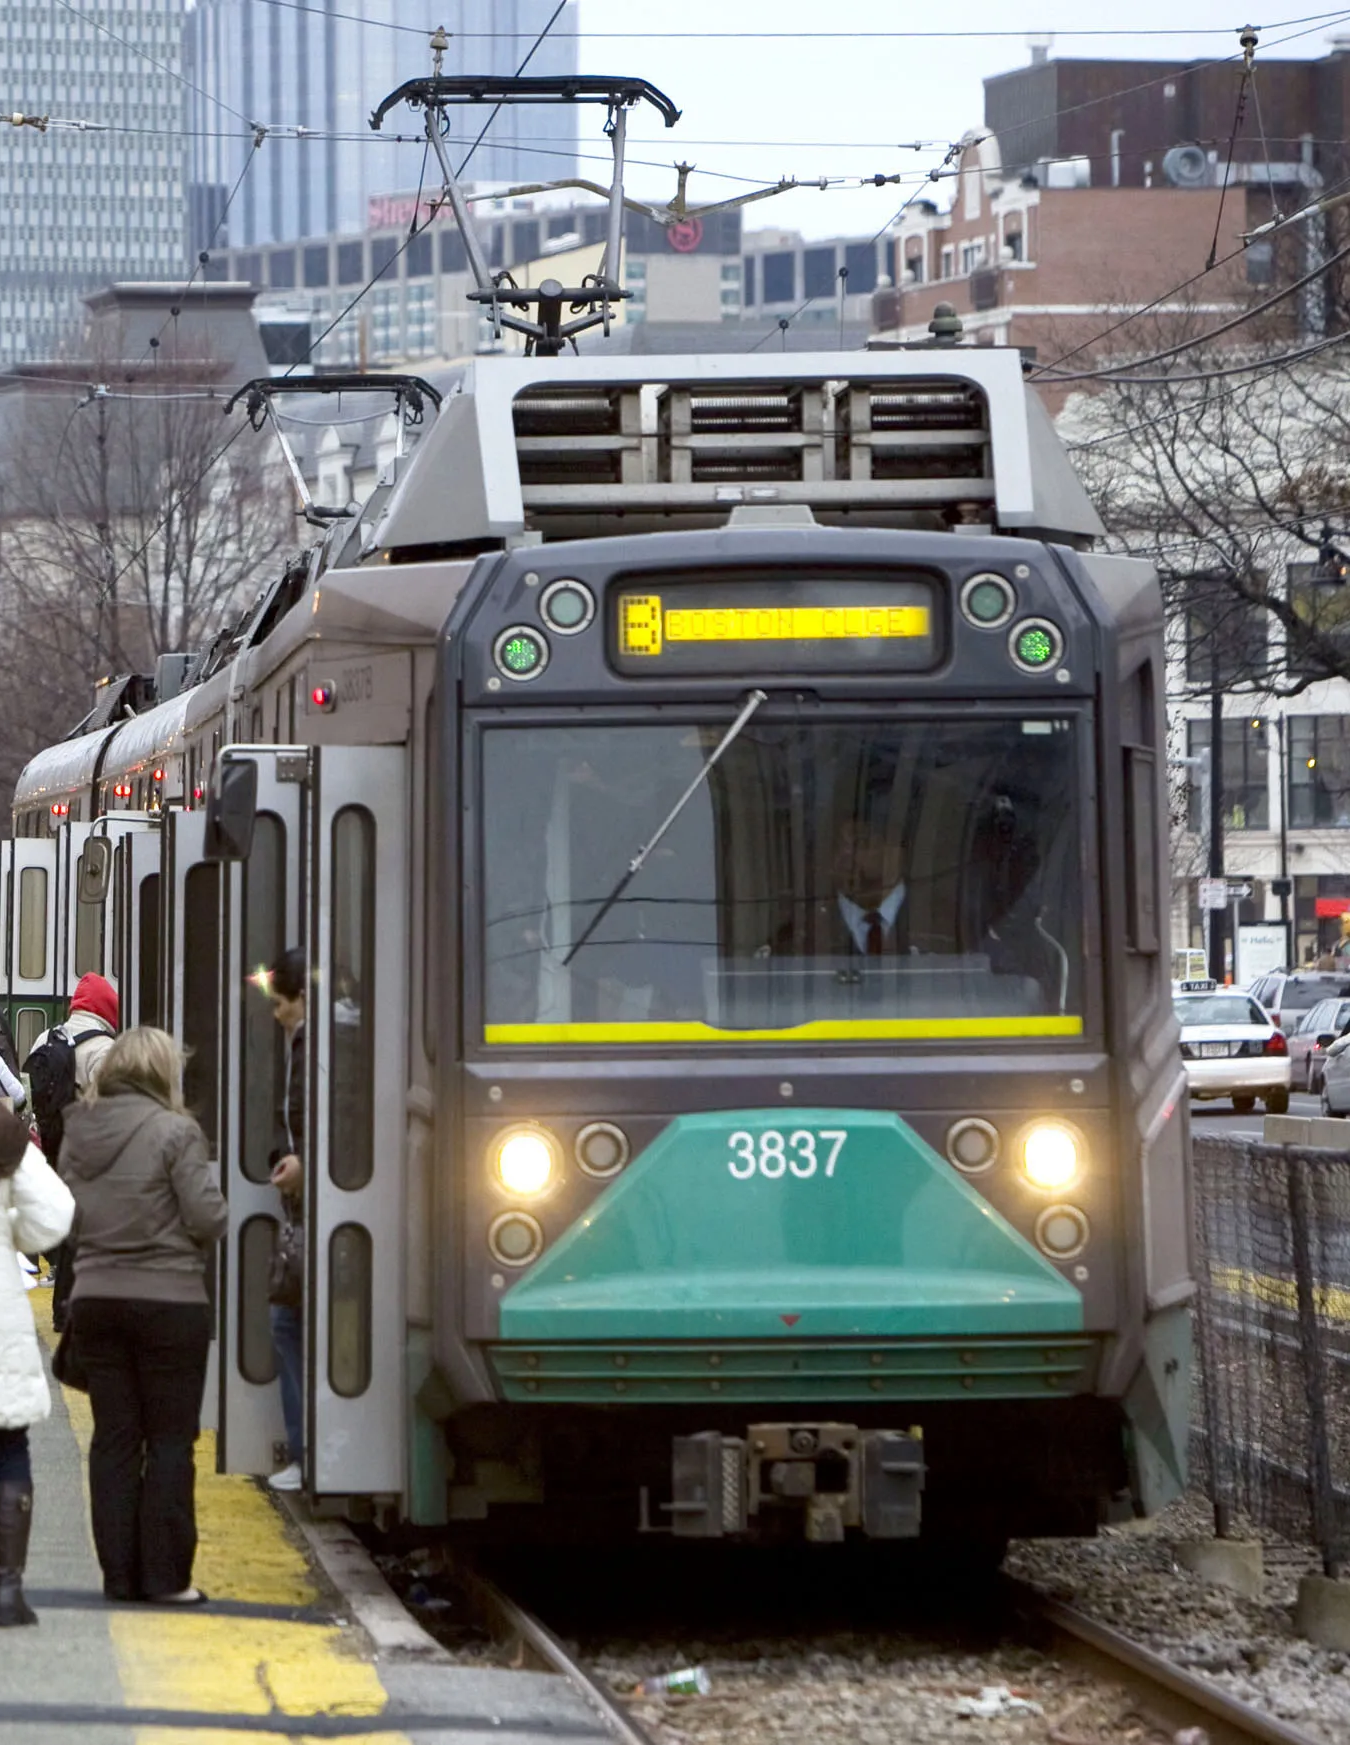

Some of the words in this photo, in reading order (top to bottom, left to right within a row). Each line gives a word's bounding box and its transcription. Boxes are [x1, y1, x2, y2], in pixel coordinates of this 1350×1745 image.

[622, 597, 658, 653] B
[669, 609, 794, 637] BOSTON
[822, 607, 905, 635] CLGE
[1190, 983, 1208, 991] TAXI
[728, 1130, 847, 1179] 3837
